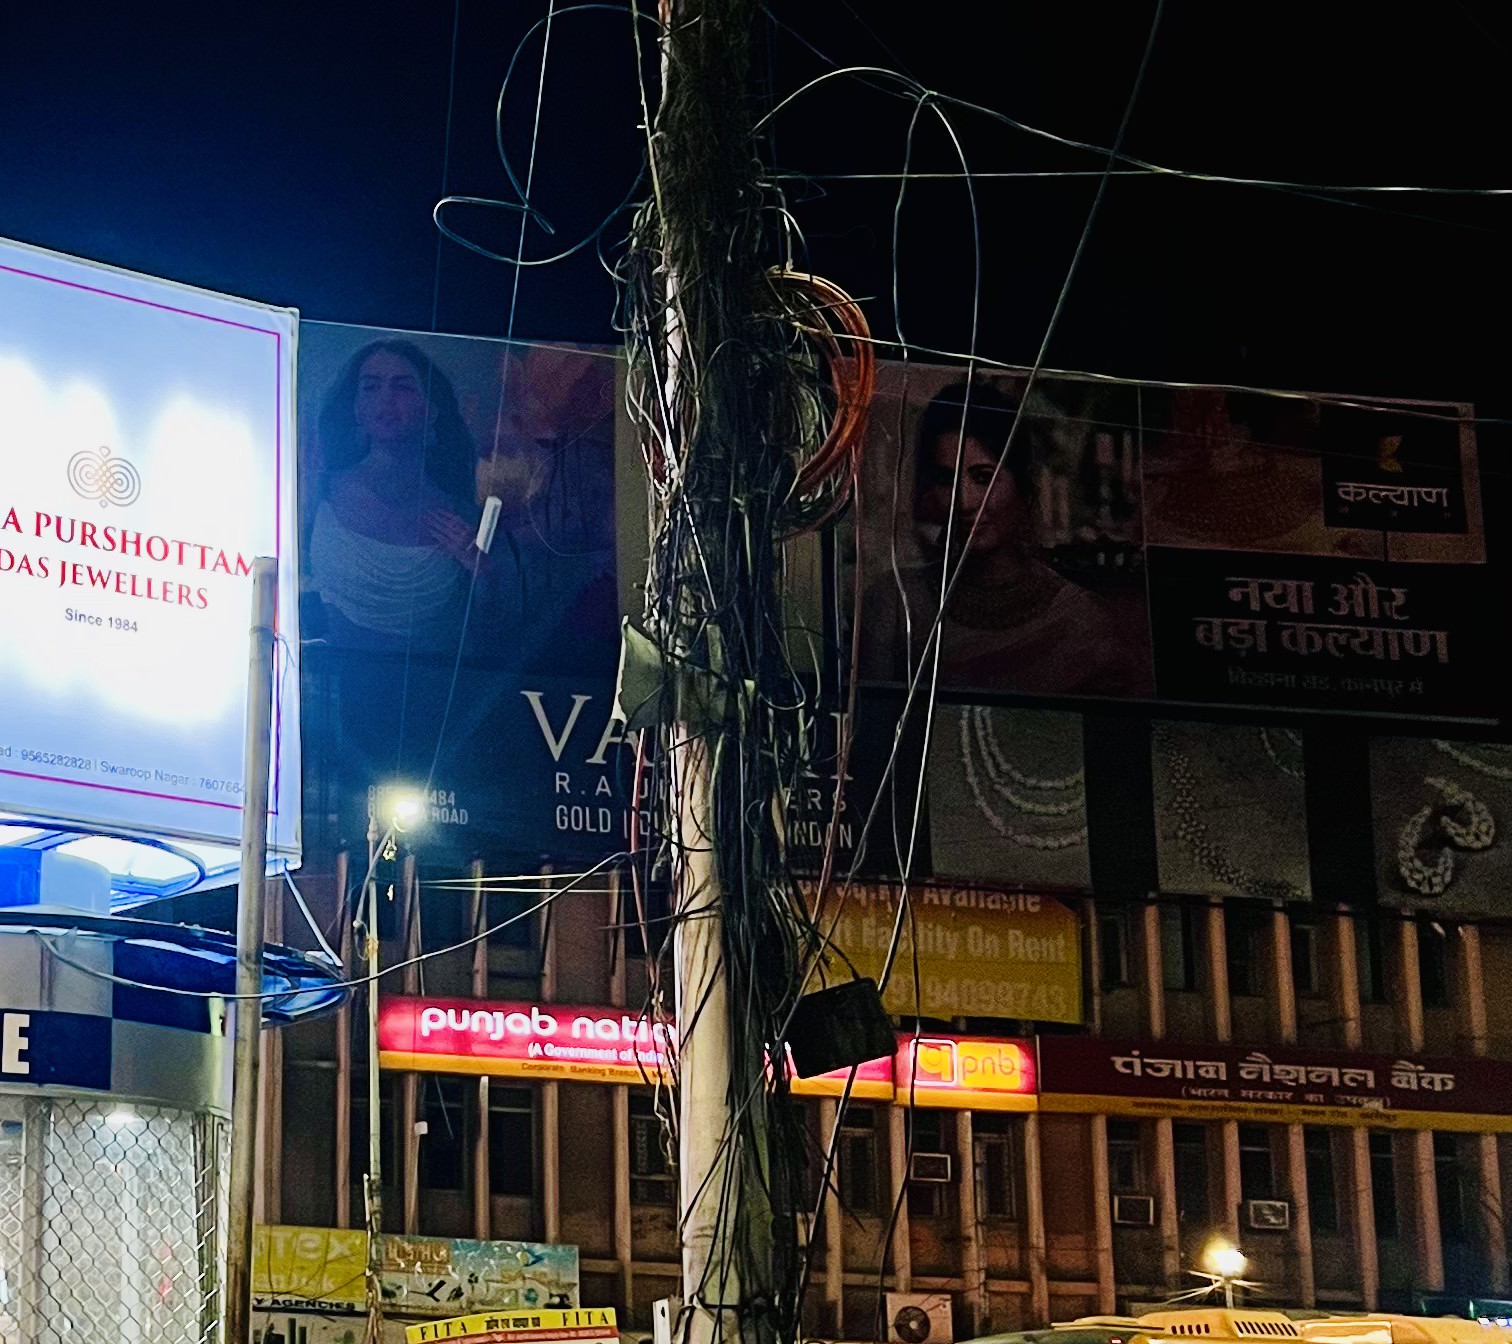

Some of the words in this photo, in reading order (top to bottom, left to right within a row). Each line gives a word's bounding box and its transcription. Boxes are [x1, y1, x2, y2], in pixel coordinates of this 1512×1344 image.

[1335, 480, 1449, 507] कल्याण
[34, 511, 256, 578] PURSHOTTAM
[59, 560, 208, 609] JEWELLERS
[1224, 576, 1315, 615] नया
[1328, 571, 1410, 620] और
[65, 607, 103, 627] Since
[108, 617, 139, 633] 1984
[1192, 617, 1268, 658] बड़ा
[1277, 621, 1449, 664] कल्याण
[101, 760, 150, 781] Swaroop
[154, 769, 189, 786] Nagar
[555, 805, 612, 833] GOLD
[967, 925, 1000, 959] On
[1008, 928, 1066, 963] Rent
[421, 1007, 558, 1041] punjab
[572, 1015, 678, 1043] natio
[544, 1042, 618, 1061] Government
[619, 1047, 634, 1062] of
[963, 1048, 1015, 1081] pnb
[1110, 1049, 1228, 1082] पंजाब
[1389, 1060, 1457, 1093] बैंक
[270, 1298, 356, 1311] AGENCIES
[562, 1311, 609, 1327] FITA
[420, 1321, 468, 1342] FITA
